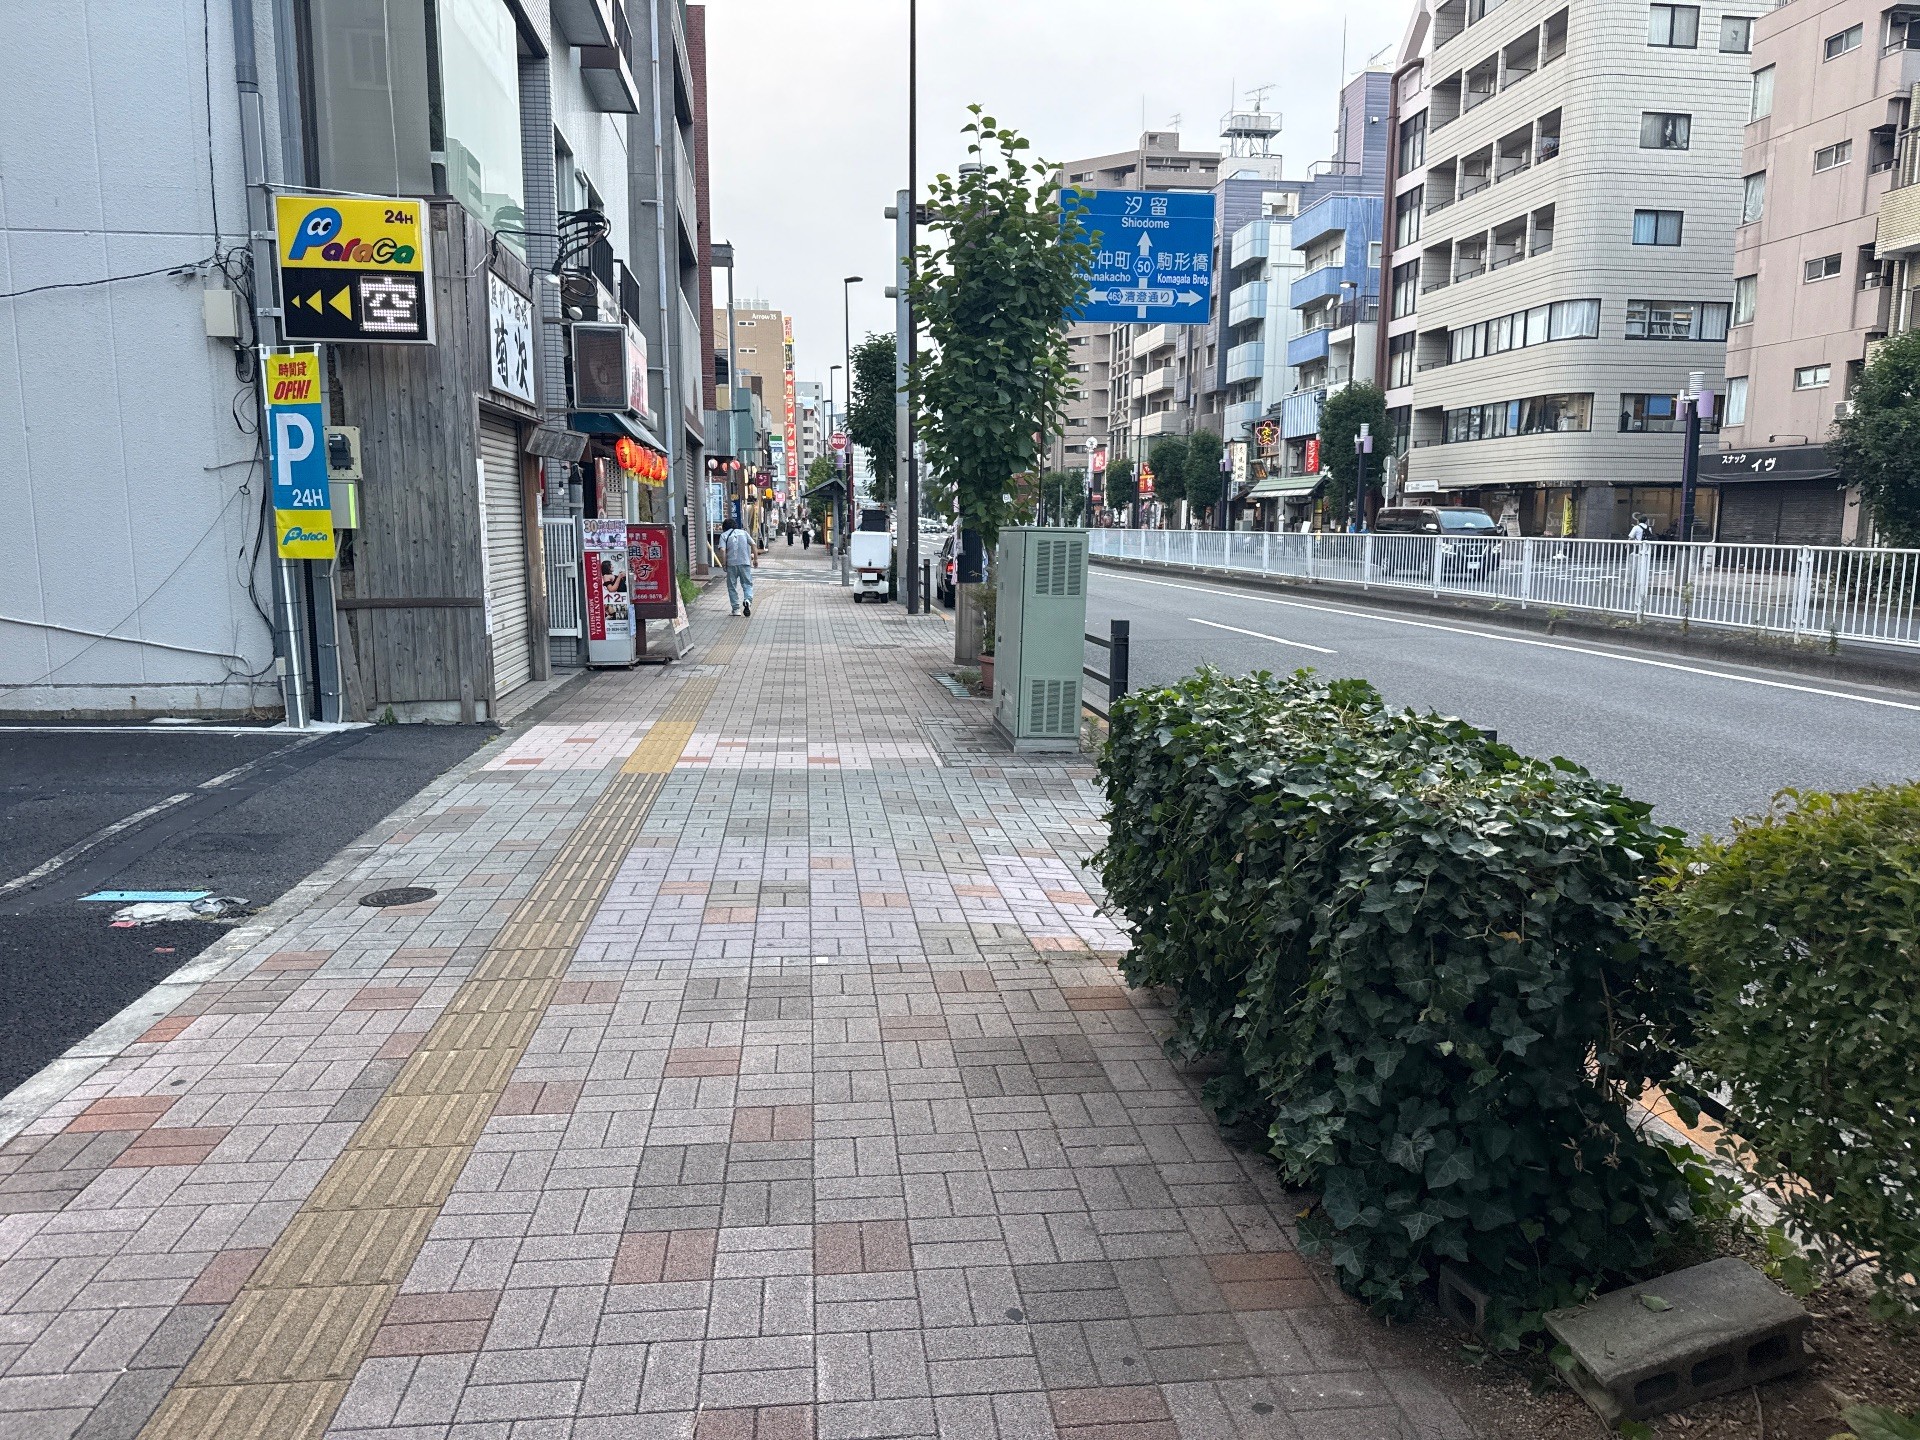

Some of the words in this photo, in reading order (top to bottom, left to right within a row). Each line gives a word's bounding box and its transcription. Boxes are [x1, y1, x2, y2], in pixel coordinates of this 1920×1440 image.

[1125, 195, 1168, 216] 汐留
[384, 209, 413, 224] 24H
[1121, 217, 1170, 229] Shiodome
[1137, 261, 1151, 273] 50
[1156, 252, 1209, 272] 駒形橋
[1157, 273, 1191, 285] Komagata
[1192, 275, 1210, 286] Brdg.
[361, 276, 418, 331] 空
[1108, 291, 1122, 301] 463
[1125, 291, 1171, 303] 清澄通り
[278, 361, 307, 378] 時間貸
[274, 379, 312, 400] OPEN!
[276, 413, 315, 486] P
[1722, 454, 1747, 464] スナック
[1751, 457, 1776, 472] イヴ
[292, 489, 324, 507] 24H
[613, 593, 626, 603] 2F
